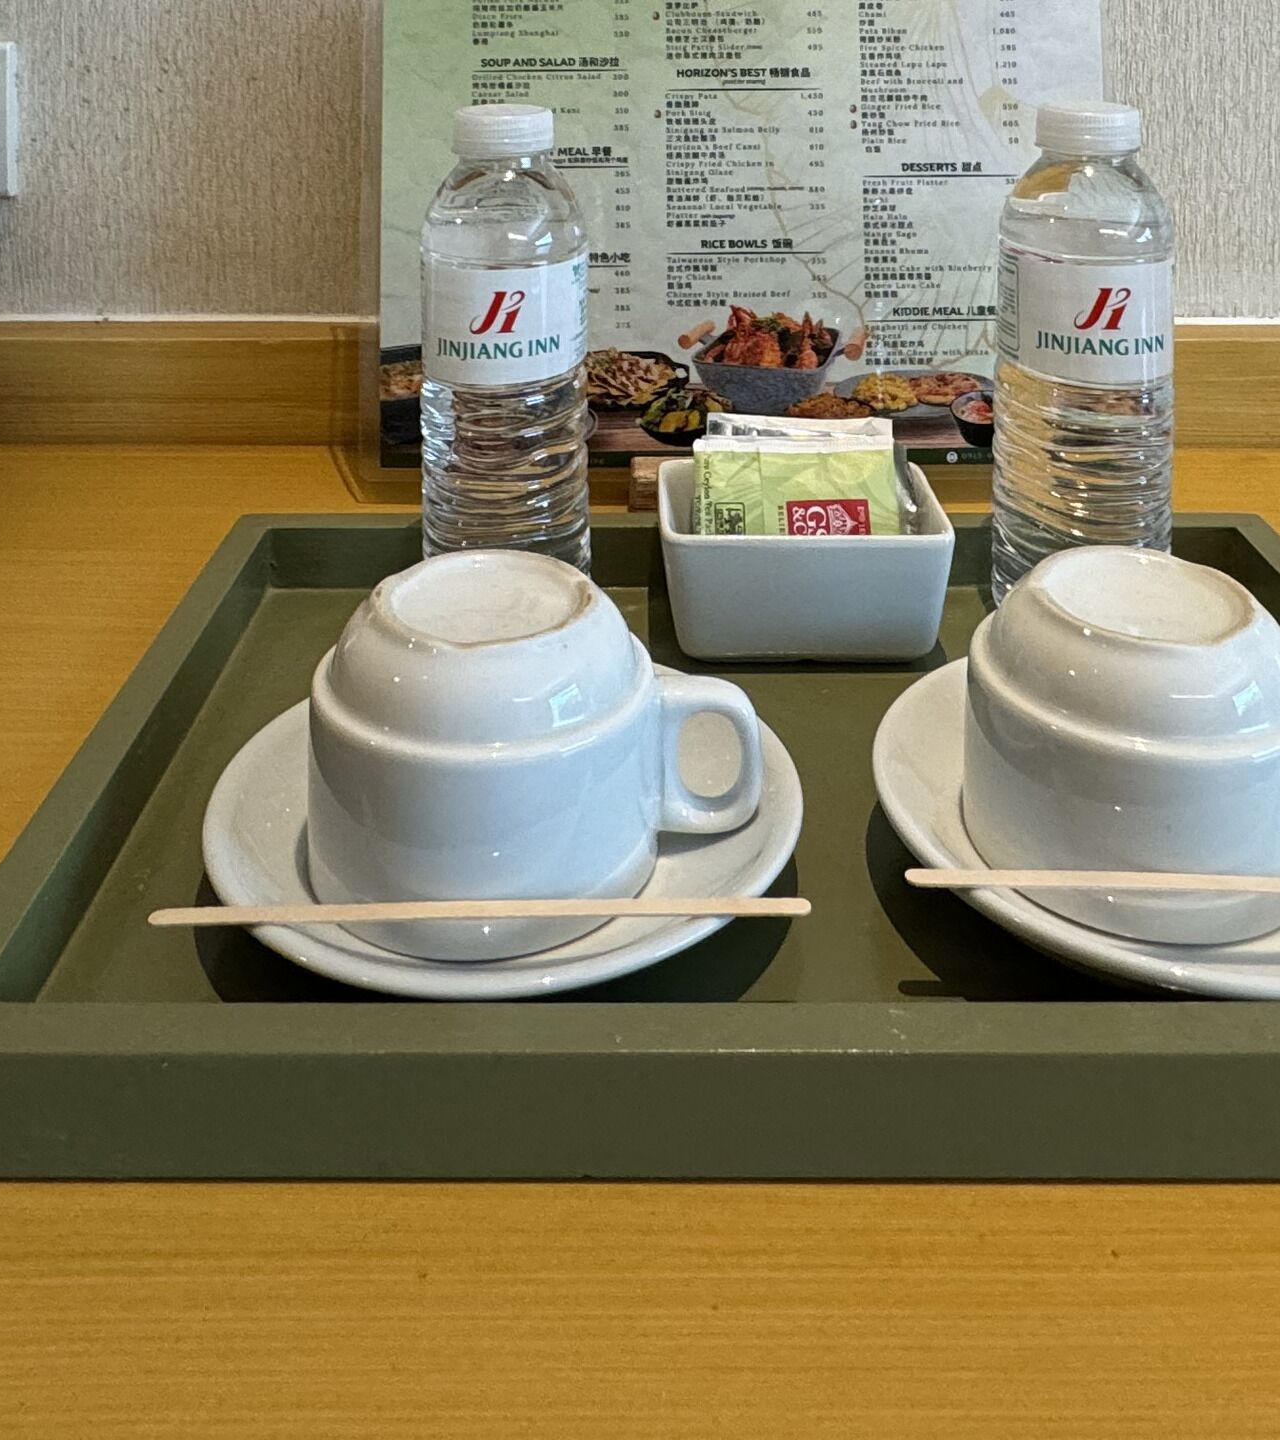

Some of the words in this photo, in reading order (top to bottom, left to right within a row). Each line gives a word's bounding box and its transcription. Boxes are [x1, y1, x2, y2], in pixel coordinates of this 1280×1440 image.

[881, 45, 905, 53] Spice
[908, 44, 945, 52] Chicken
[480, 58, 511, 68] SOUP
[513, 58, 537, 67] AND
[539, 57, 576, 67] SALAD
[578, 57, 620, 68] 汤和沙拉
[676, 68, 738, 78] HORIZON'S
[740, 68, 767, 77] BEST
[861, 103, 891, 111] Ginger
[861, 120, 883, 129] Yang
[557, 147, 589, 157] MEAL
[666, 161, 696, 169] Crispy
[699, 160, 722, 168] Fried
[726, 160, 762, 168] Chicken
[901, 163, 957, 172] DESSERTS
[737, 203, 782, 212] Vegetable
[863, 231, 893, 240] Mango
[701, 240, 726, 249] RICE
[728, 240, 767, 249] BOWLS
[717, 257, 740, 265] Style
[947, 265, 992, 273] Blueberry
[706, 290, 730, 299] Style
[733, 290, 767, 298] Braised
[892, 306, 930, 317] KIDDIE
[932, 306, 964, 316] MEAL
[437, 336, 523, 360] JINJIANG
[528, 334, 561, 357] INN
[1036, 330, 1129, 356] JINJIANG
[1134, 334, 1165, 355] INN
